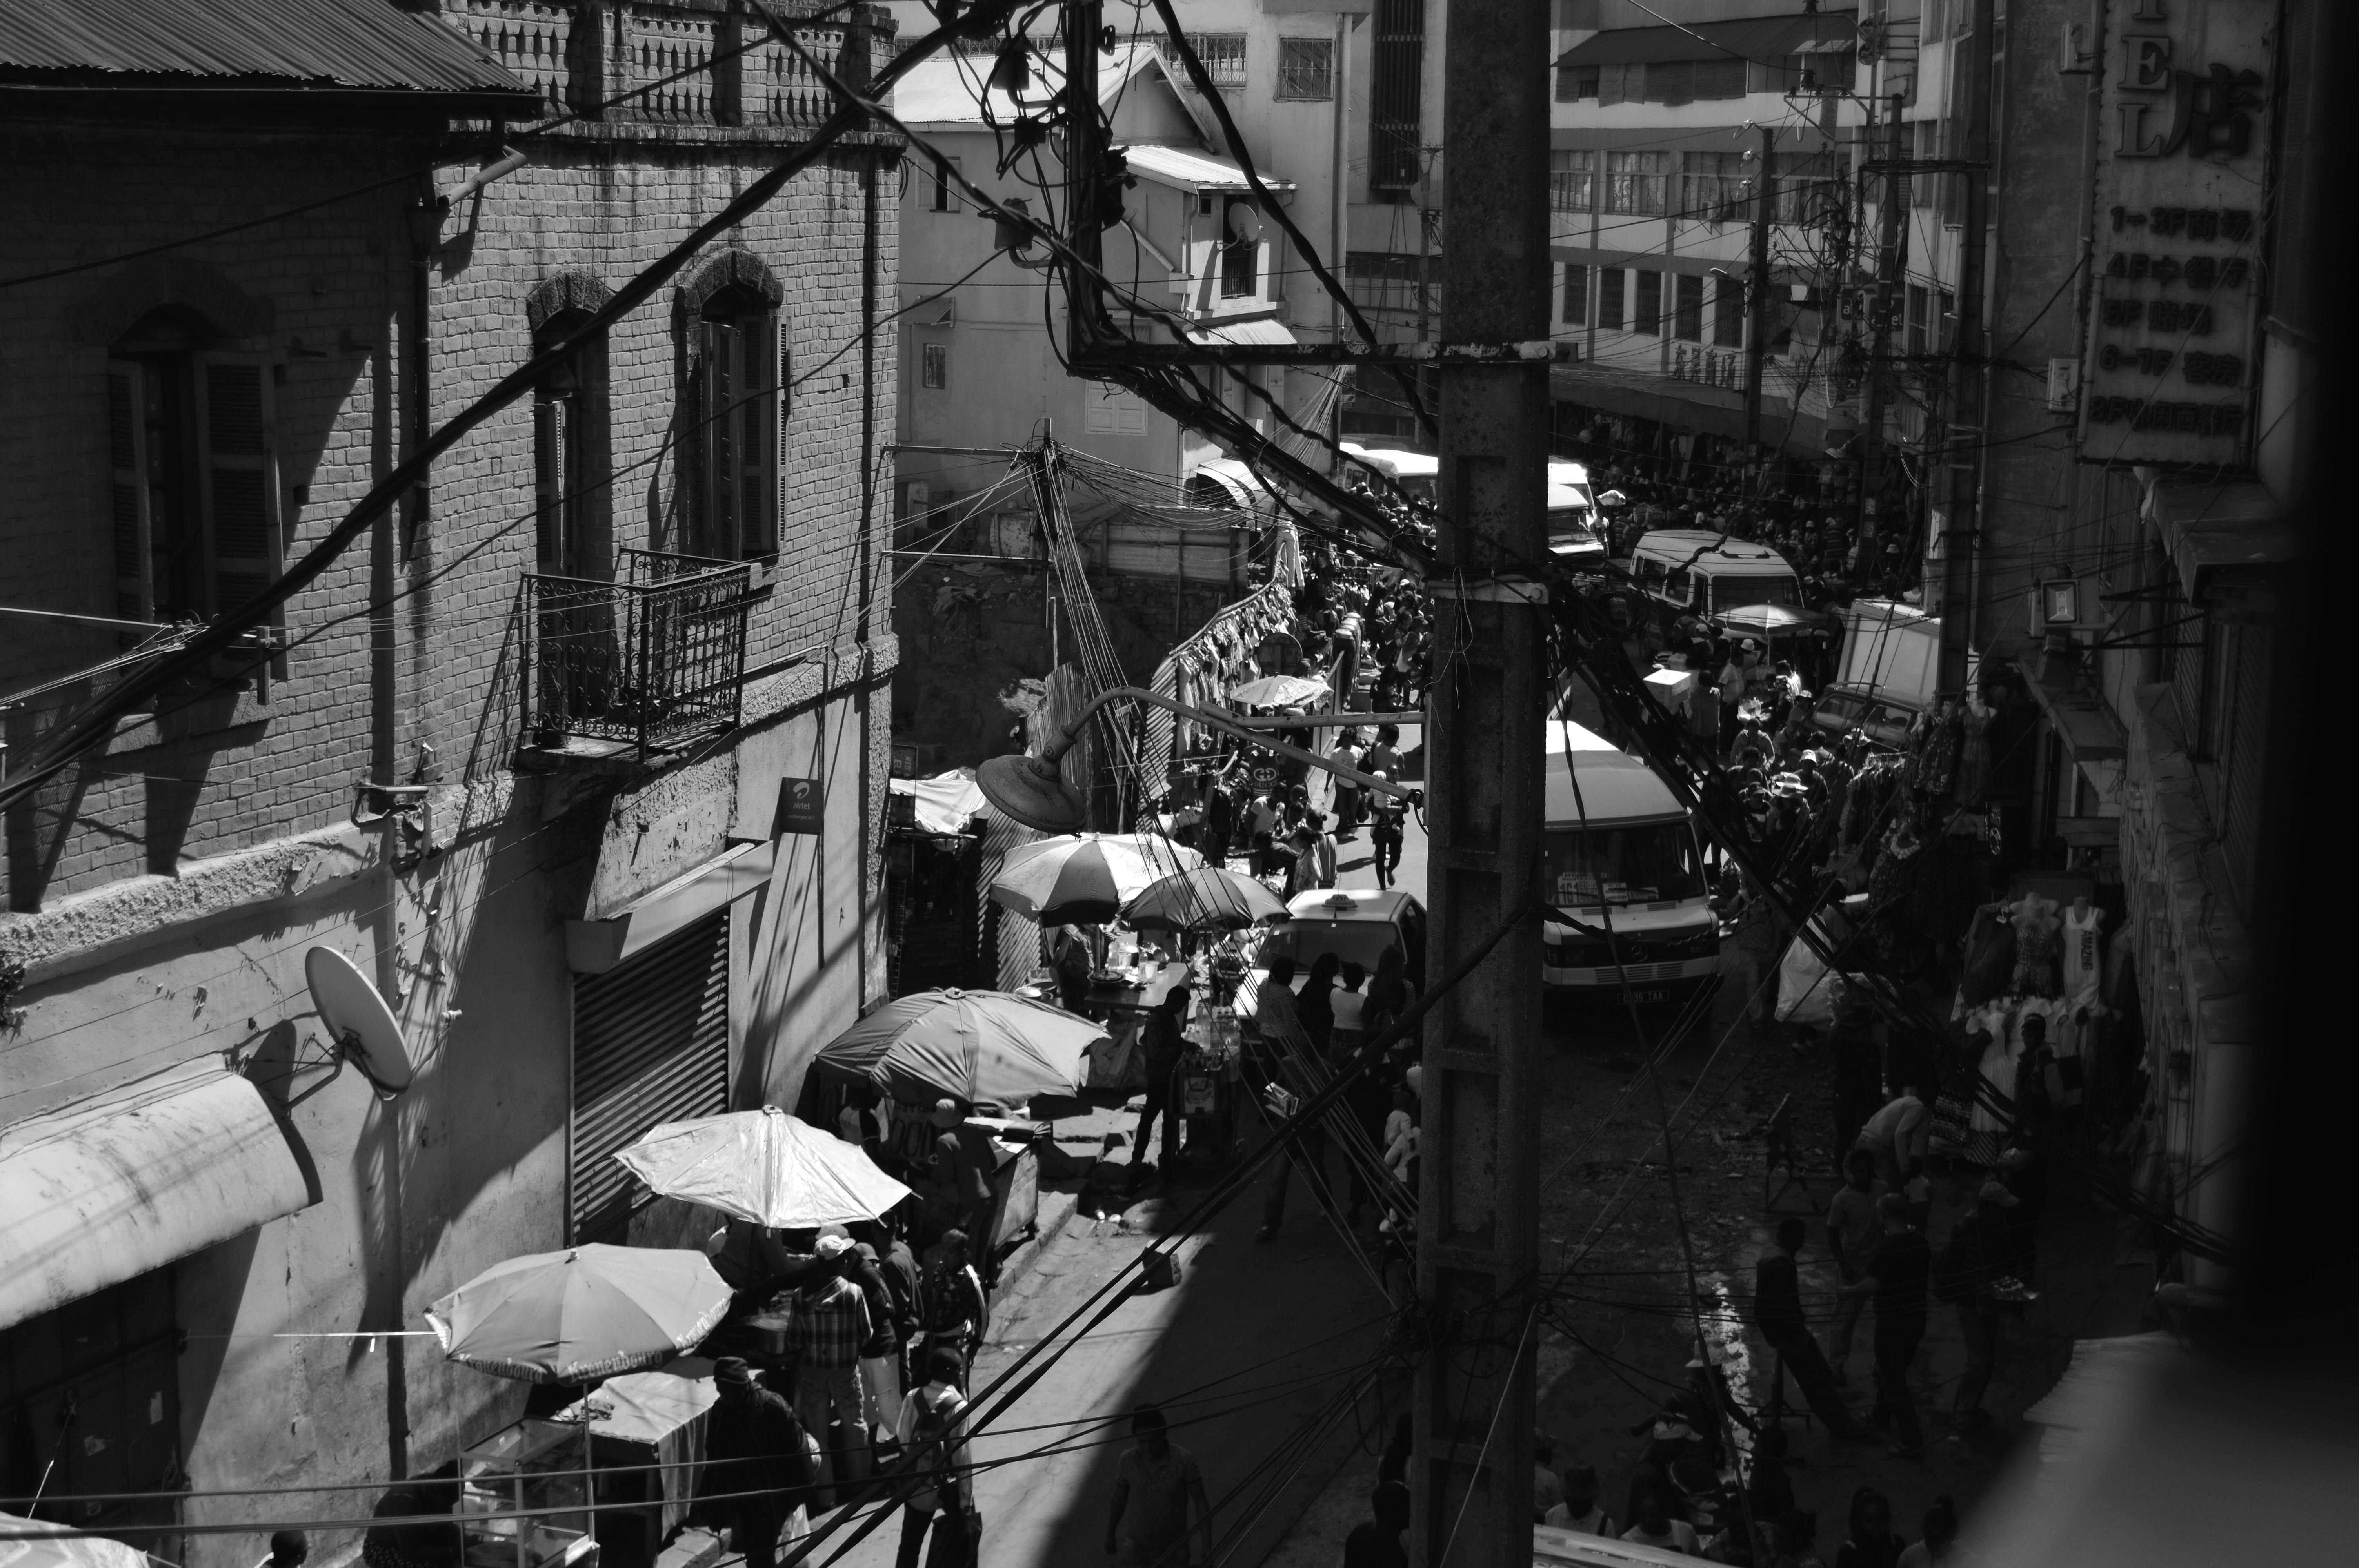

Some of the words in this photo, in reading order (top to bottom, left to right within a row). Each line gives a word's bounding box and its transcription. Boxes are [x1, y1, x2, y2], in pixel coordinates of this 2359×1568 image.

[2163, 63, 2262, 157] 店
[1560, 882, 1579, 904] 161
[2081, 929, 2093, 971] AMAZING
[1623, 993, 1643, 1003] 035
[1648, 992, 1663, 1001] TAA
[566, 1350, 663, 1383] Kronenbourg
